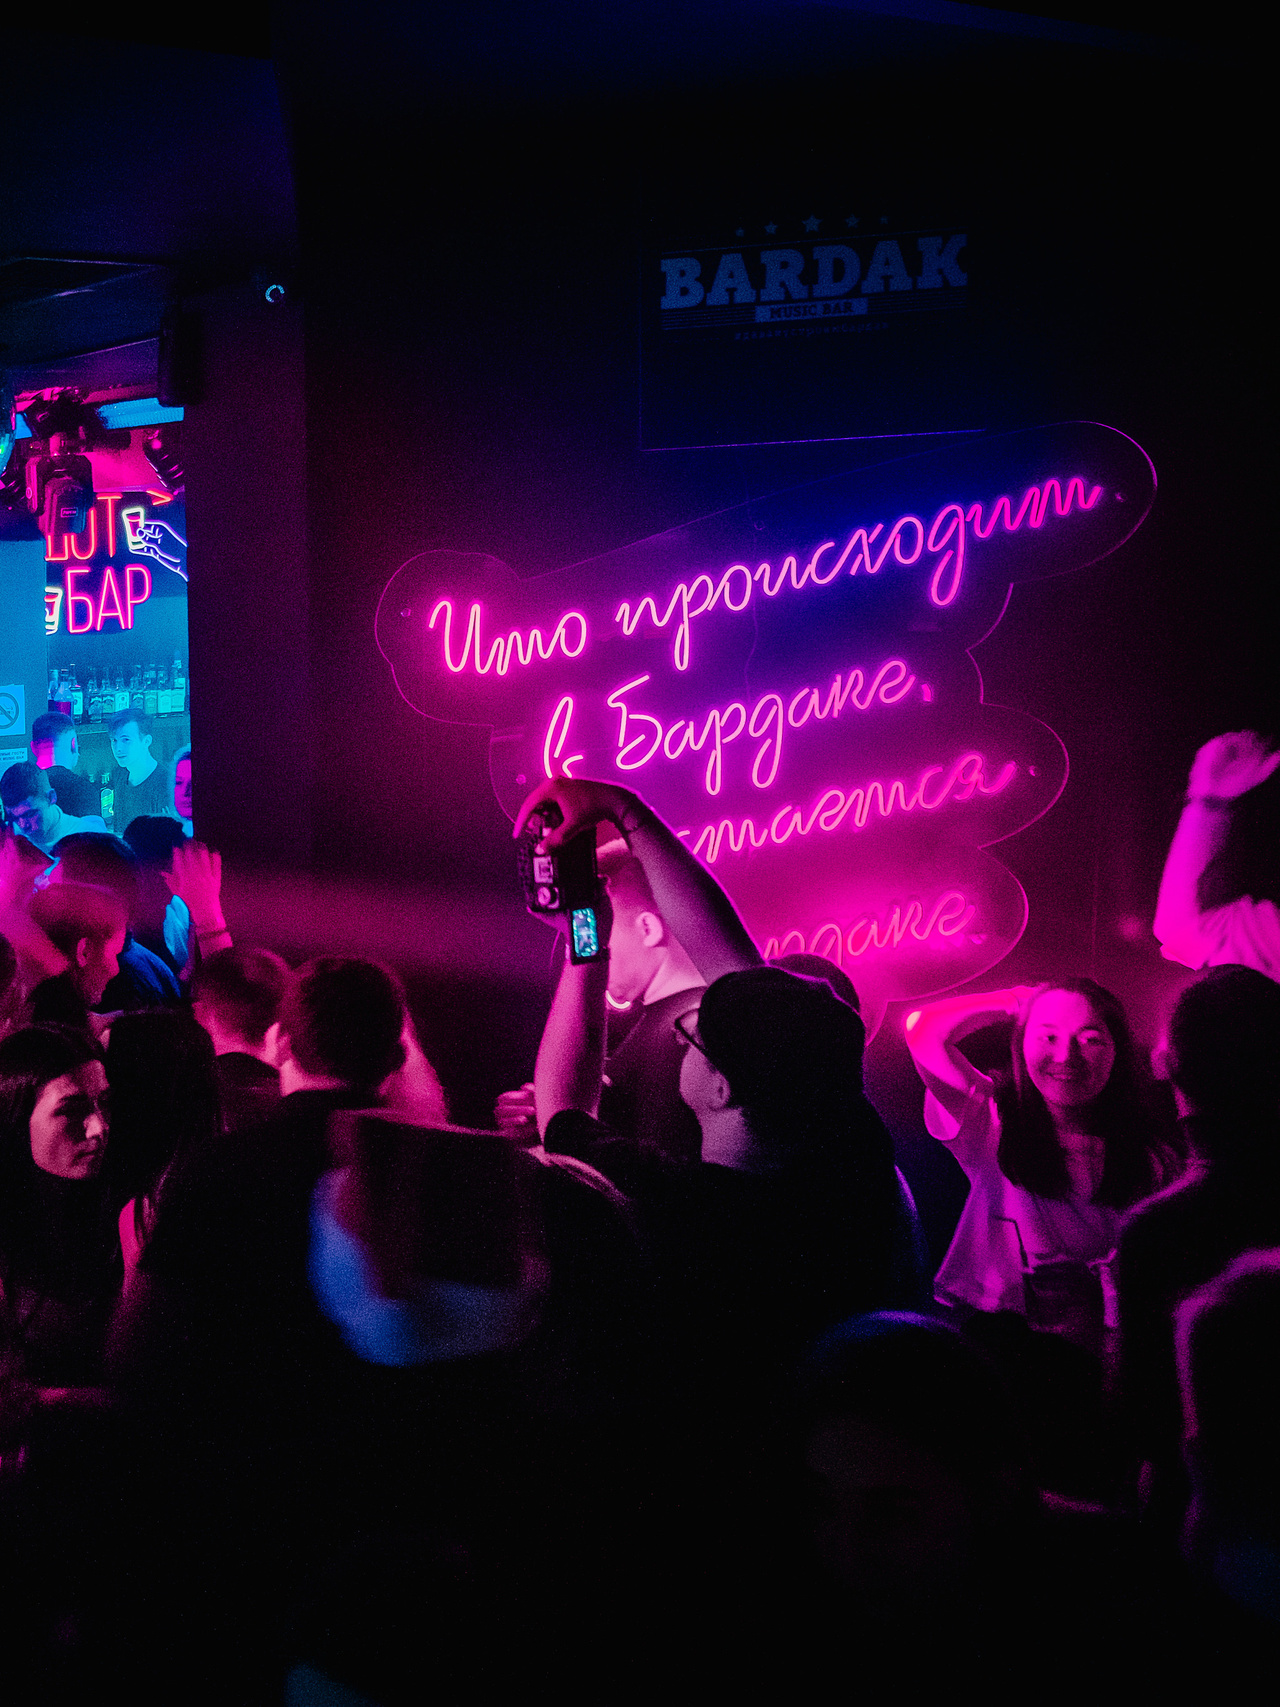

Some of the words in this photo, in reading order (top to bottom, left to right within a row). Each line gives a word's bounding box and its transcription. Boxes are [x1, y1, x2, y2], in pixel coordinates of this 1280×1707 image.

[660, 233, 968, 309] BARDAK
[770, 305, 817, 319] MUSIC
[822, 302, 853, 315] BAR
[65, 564, 152, 633] БАР
[427, 599, 588, 676] Что
[614, 475, 1103, 671] происходит
